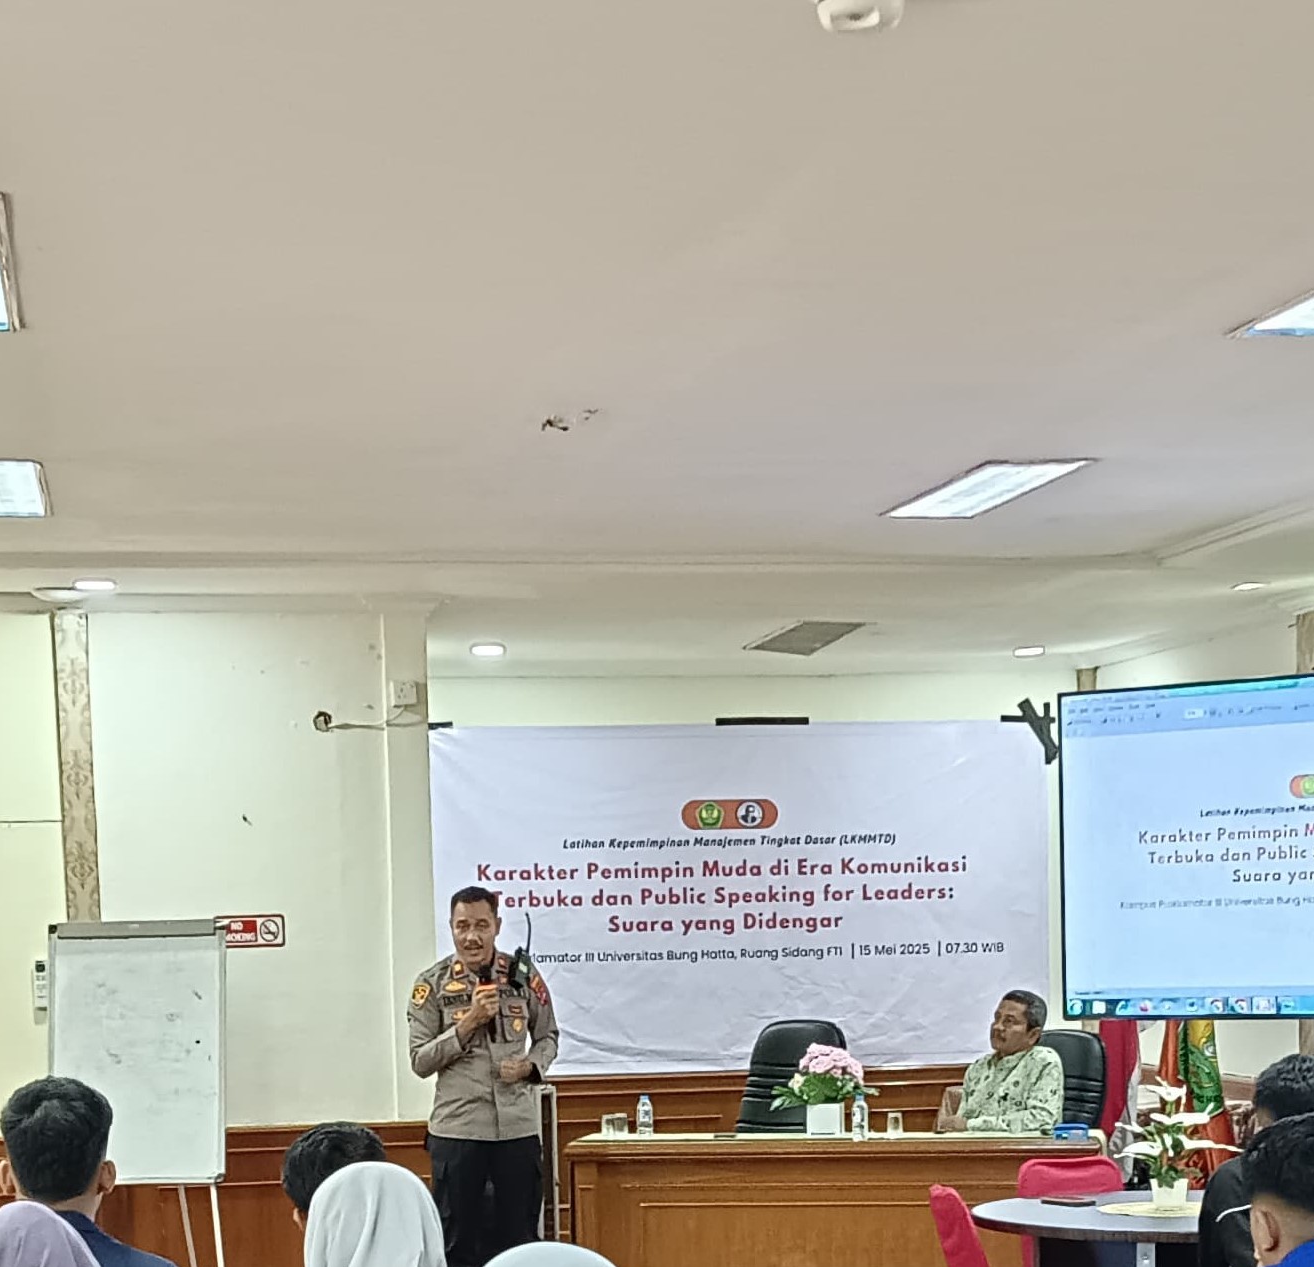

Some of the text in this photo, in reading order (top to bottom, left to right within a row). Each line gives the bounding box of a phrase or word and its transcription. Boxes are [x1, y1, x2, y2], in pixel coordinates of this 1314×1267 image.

[563, 833, 896, 850] Latihan Kepemimpinan Manajemen Tingkat Dasar (LKMMTD)
[1138, 828, 1211, 845] Karakter
[1217, 825, 1298, 842] Pemimpin
[1148, 849, 1214, 864] Terbuka
[1220, 847, 1251, 862] dan
[1257, 845, 1307, 861] Public
[477, 855, 967, 883] Karakter Pemimpin Muda di Era Komunikasi
[1232, 869, 1281, 883] Suara
[591, 888, 633, 906] dan
[640, 887, 706, 906] Public
[714, 884, 815, 908] Speaking
[823, 883, 854, 901] for
[862, 882, 954, 901] Leaders:
[608, 912, 844, 936] Suara yang Didengar
[533, 952, 582, 964] lamator
[597, 949, 664, 963] Universitas
[666, 949, 698, 964] Bung
[701, 948, 737, 962] Hatta,
[741, 947, 778, 961] Ruang
[781, 946, 824, 961] Sidang
[827, 946, 843, 958] FTI
[859, 944, 871, 957] 15
[874, 943, 896, 956] Mei
[899, 942, 930, 956] 2025
[945, 942, 978, 954] 07.30
[981, 941, 1004, 954] WIB
